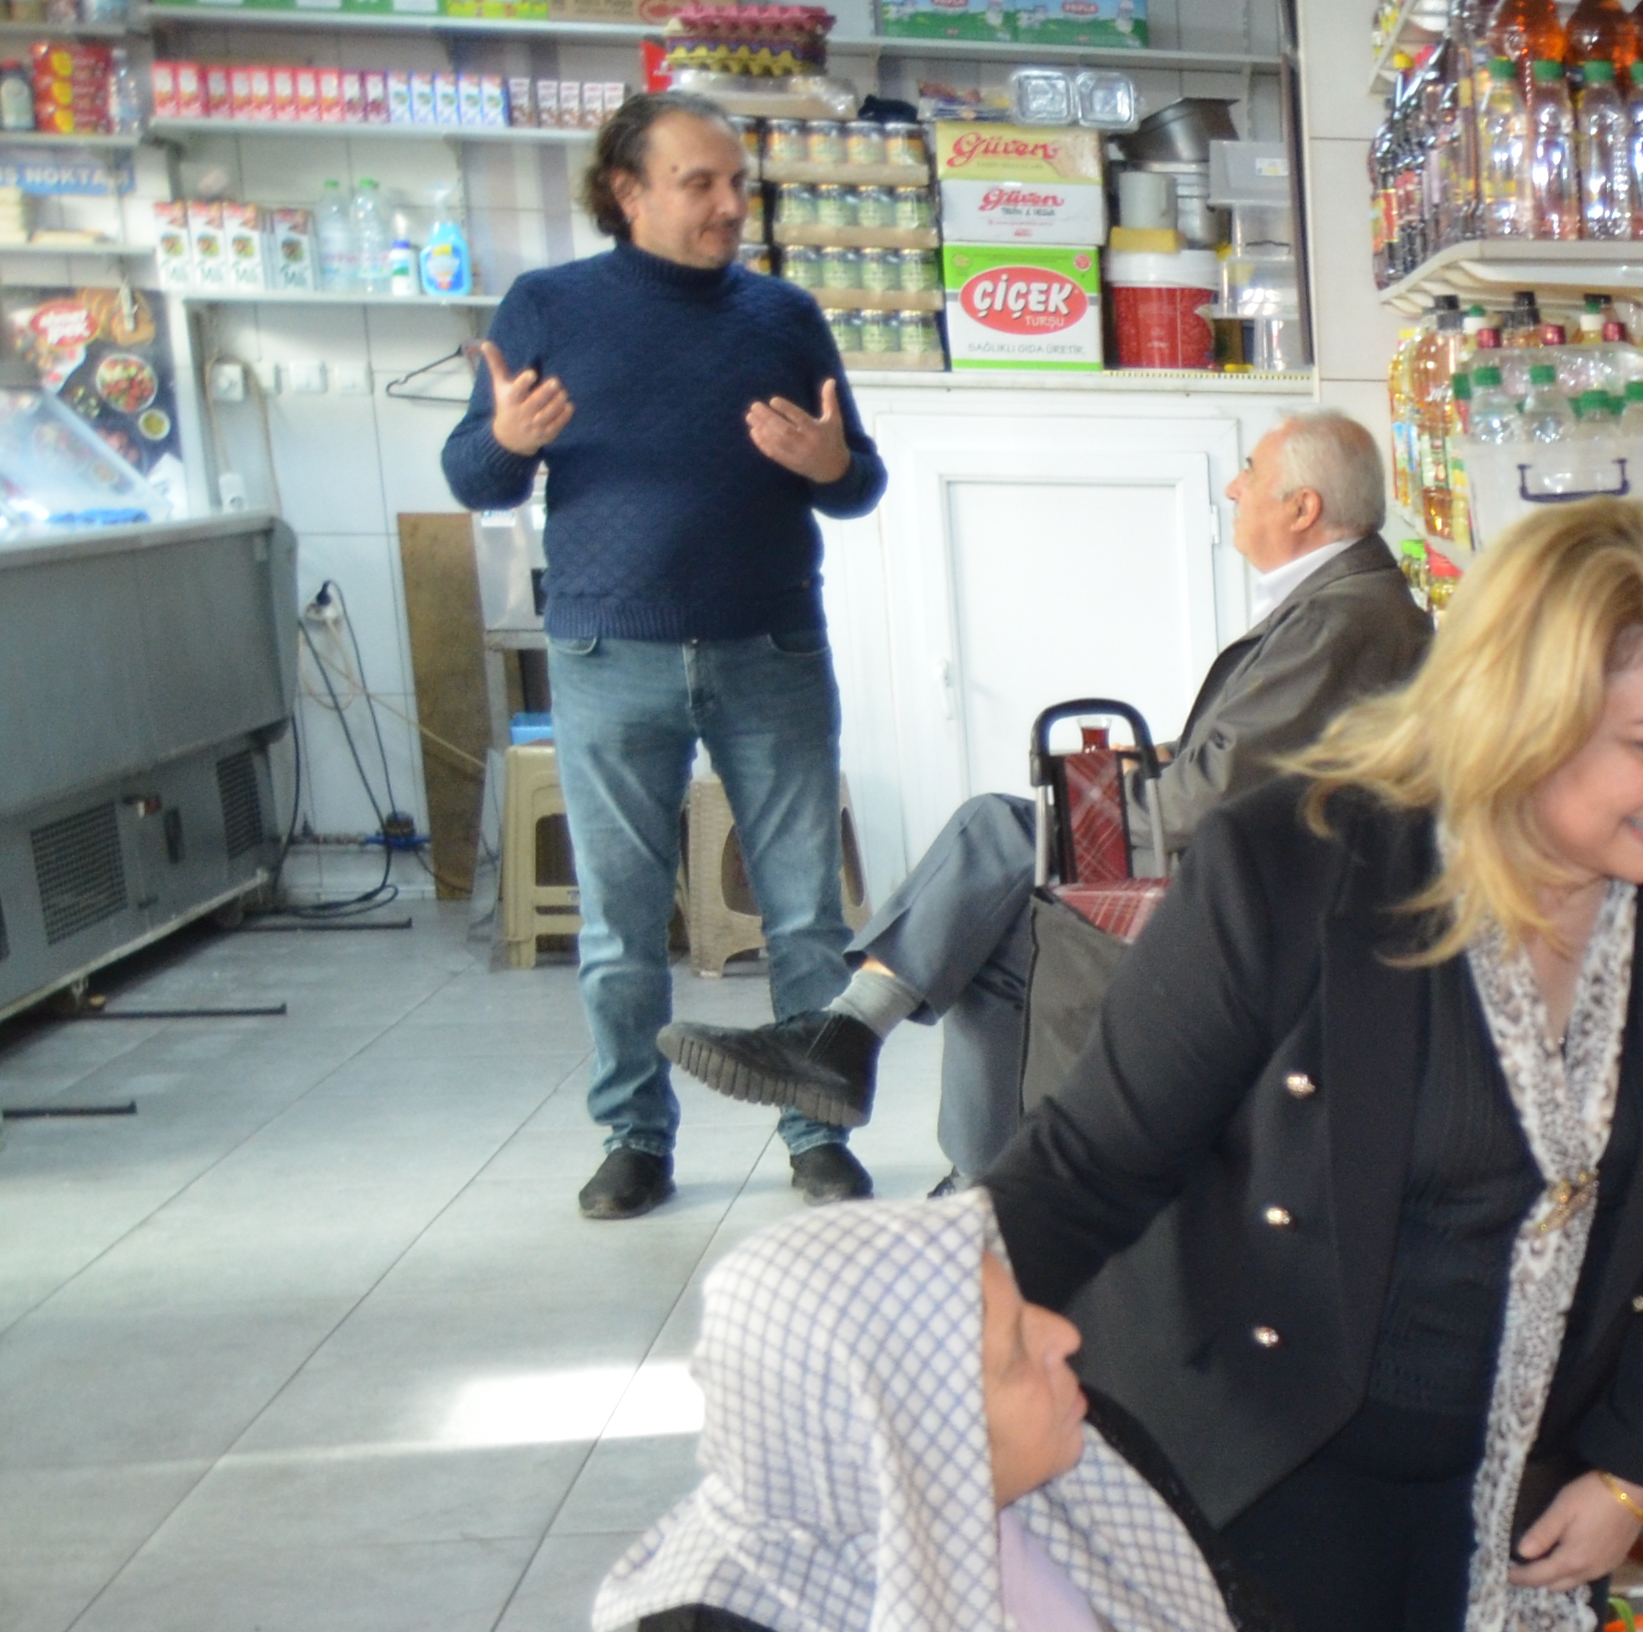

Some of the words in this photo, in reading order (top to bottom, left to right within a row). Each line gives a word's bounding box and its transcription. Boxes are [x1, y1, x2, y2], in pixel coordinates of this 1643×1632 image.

[946, 132, 1058, 167] Güven
[973, 273, 1074, 319] ÇİÇEK
[1026, 316, 1065, 329] TURŞU
